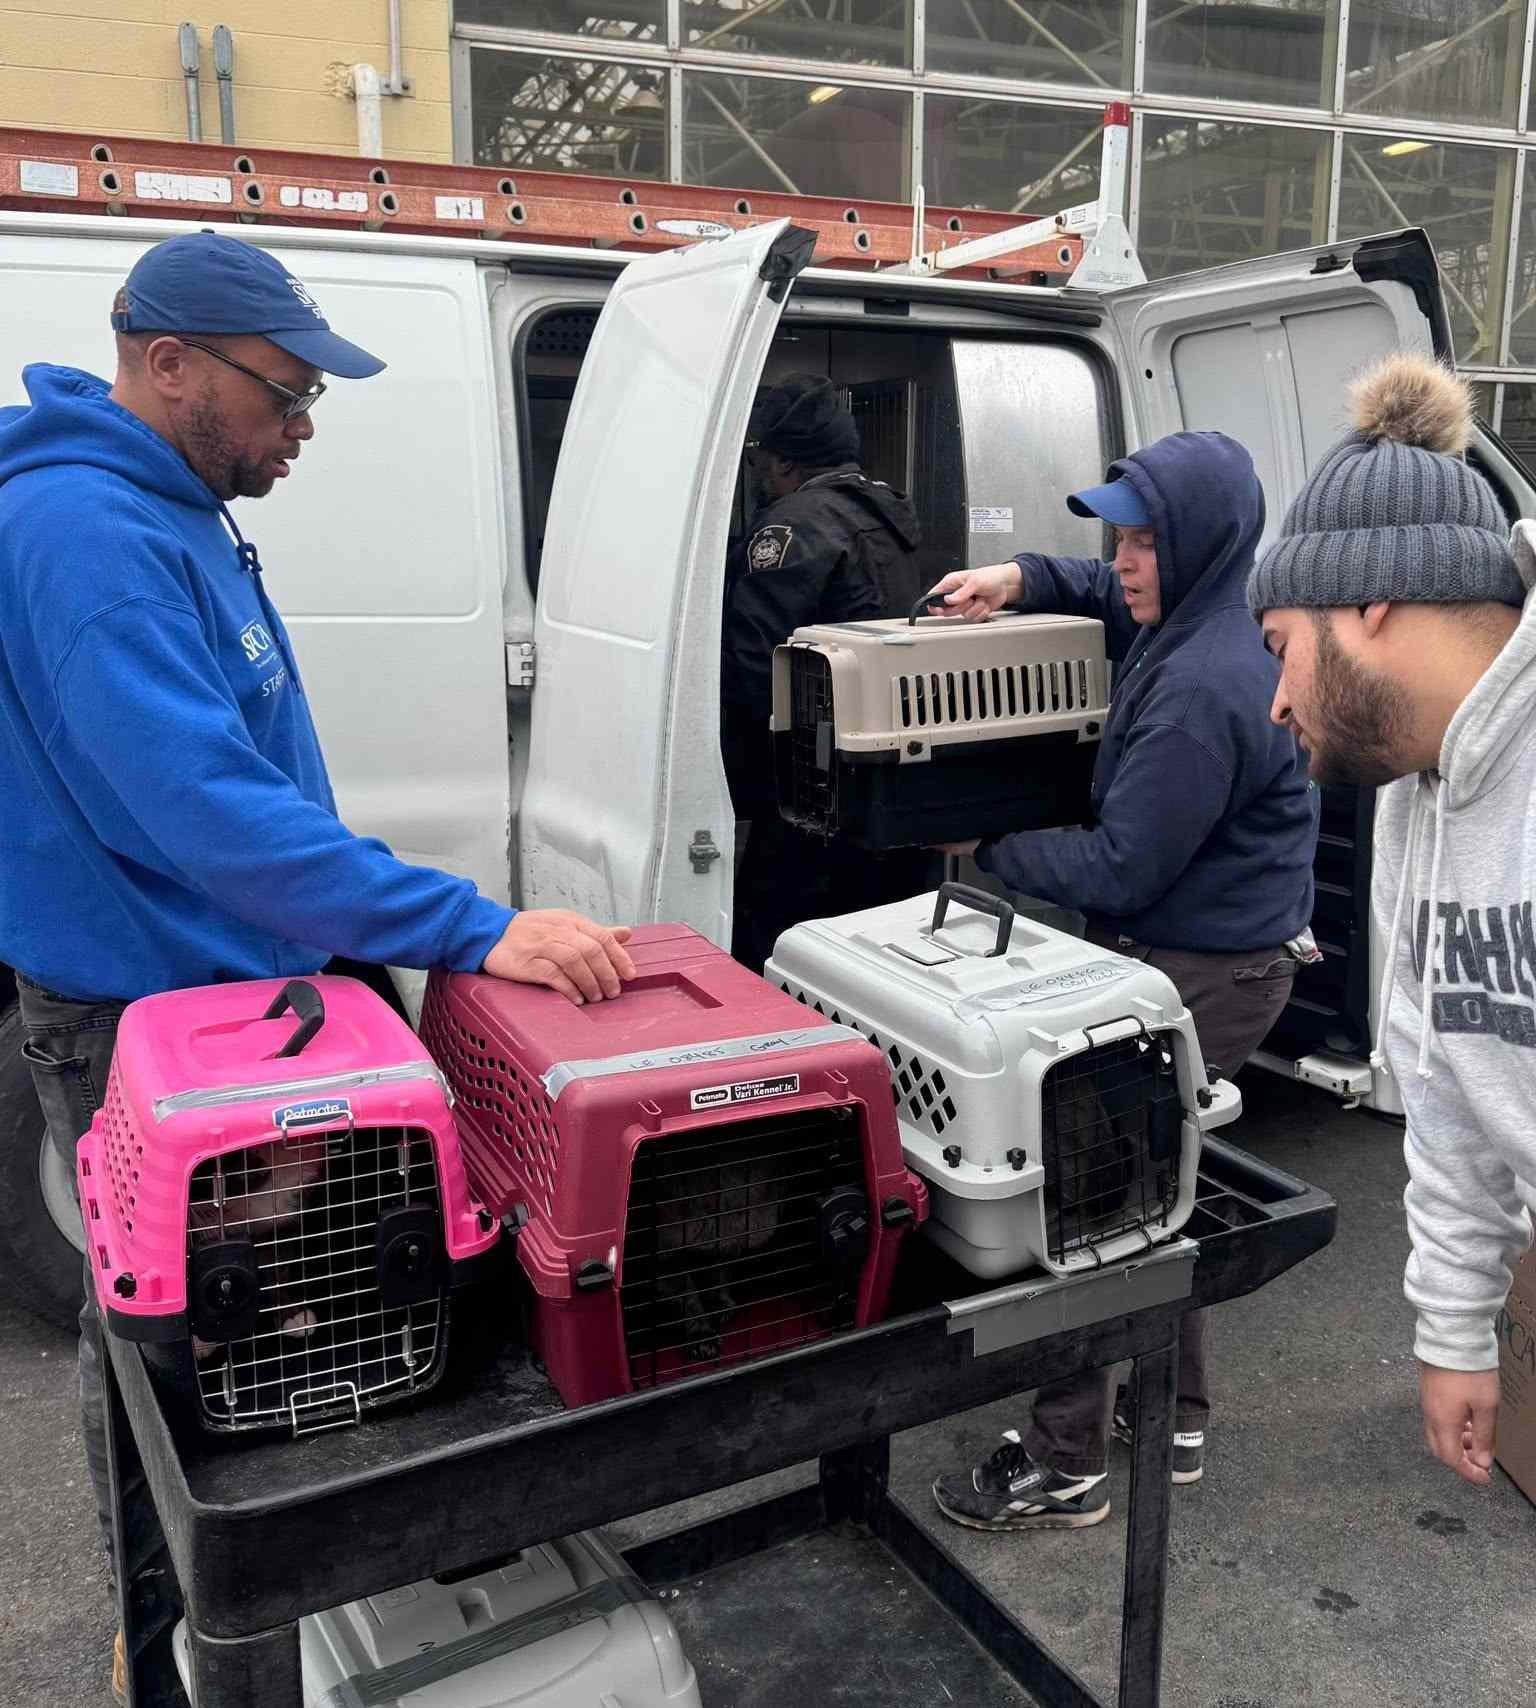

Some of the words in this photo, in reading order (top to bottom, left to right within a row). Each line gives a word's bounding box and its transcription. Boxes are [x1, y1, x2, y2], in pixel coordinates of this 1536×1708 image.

[734, 1082, 765, 1092] Deluxe
[735, 1090, 751, 1099] Vari
[753, 1084, 782, 1096] Kennel
[284, 1103, 340, 1120] Petmate
